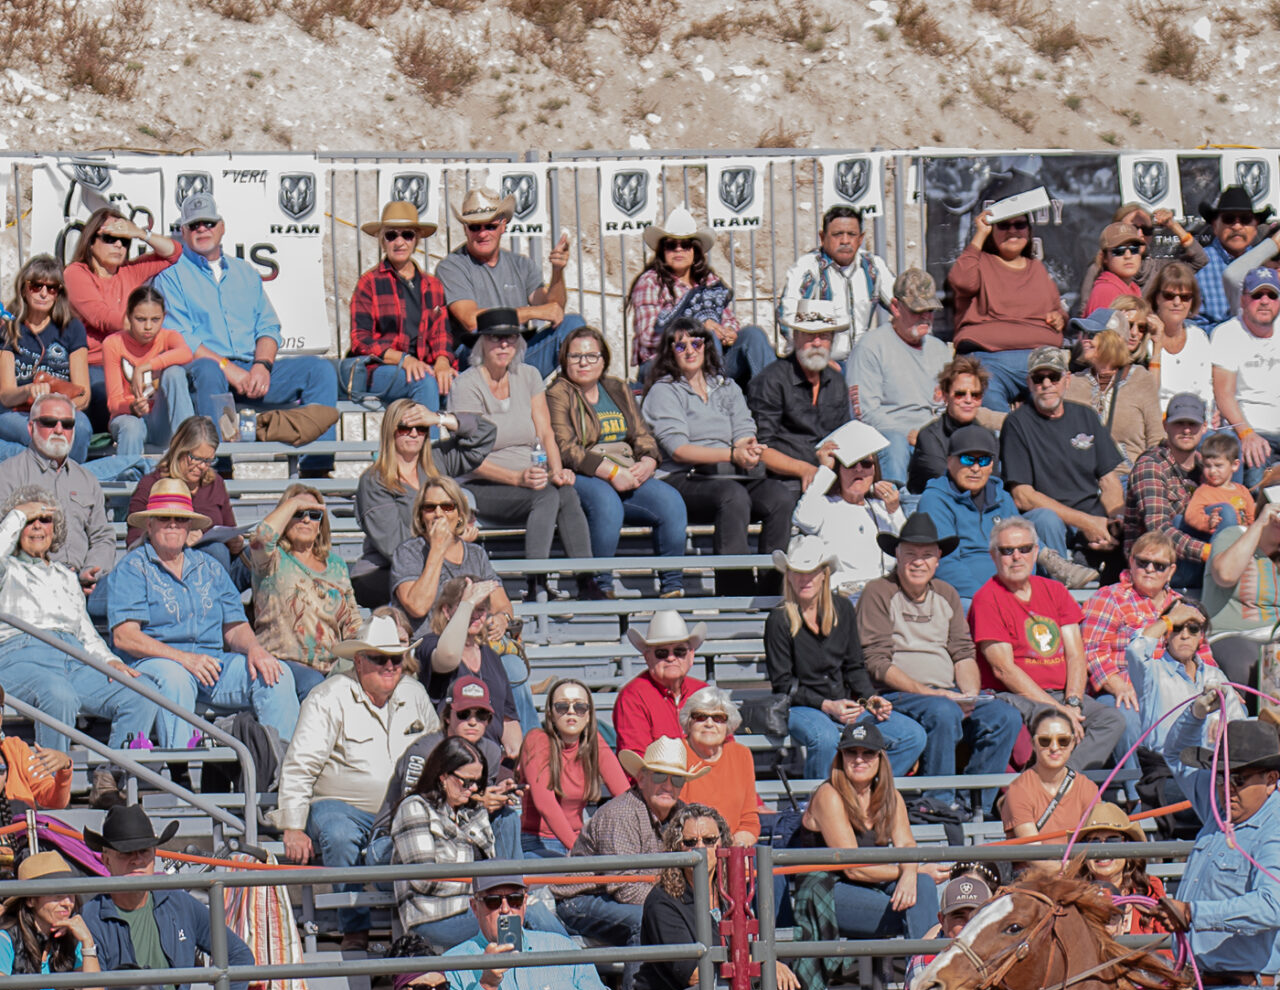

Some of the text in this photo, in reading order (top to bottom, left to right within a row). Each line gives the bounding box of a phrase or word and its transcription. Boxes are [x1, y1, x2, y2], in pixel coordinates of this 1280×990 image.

[606, 220, 653, 231] RAM
[713, 217, 760, 227] RAM
[270, 224, 320, 234] RAM
